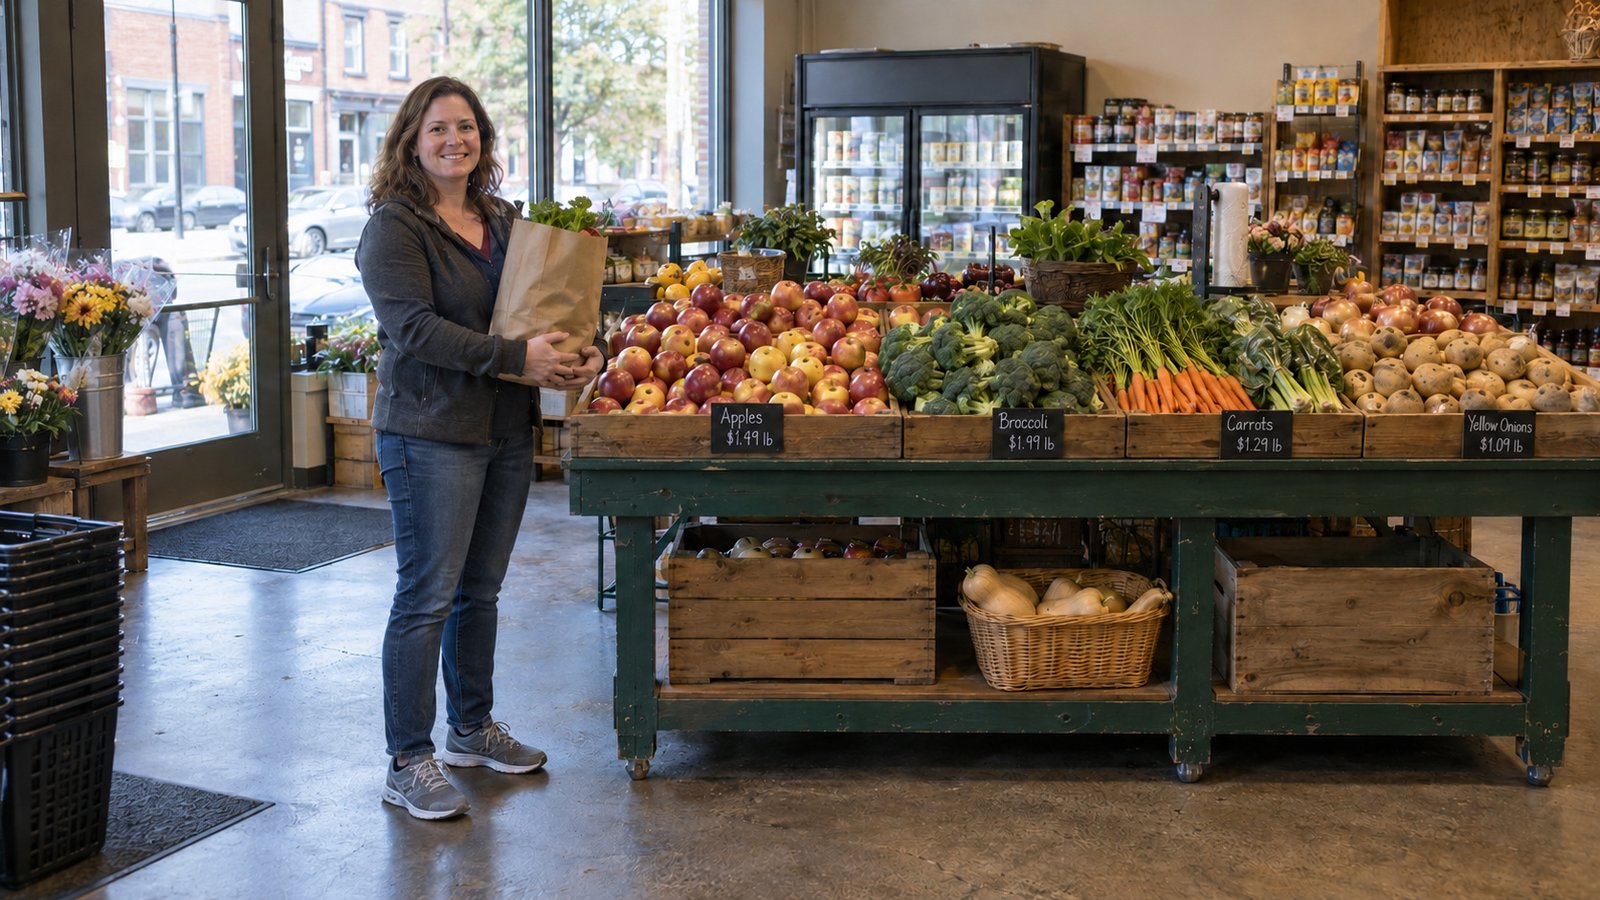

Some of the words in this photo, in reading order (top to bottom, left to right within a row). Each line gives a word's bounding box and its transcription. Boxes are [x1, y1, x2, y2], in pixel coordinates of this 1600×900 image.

[720, 407, 763, 429] Apples
[998, 411, 1048, 429] Broccoli
[1226, 414, 1273, 431] Carrots
[1467, 414, 1498, 433] Yellow
[1500, 417, 1533, 434] Onions
[726, 429, 759, 446] $1.49
[763, 431, 773, 446] lb
[1008, 434, 1040, 452] $1.99
[1044, 436, 1055, 450] lb
[1236, 436, 1268, 453] $1.29
[1272, 438, 1282, 452] lb
[1479, 436, 1510, 453] $1.09
[1513, 439, 1523, 453] lb
